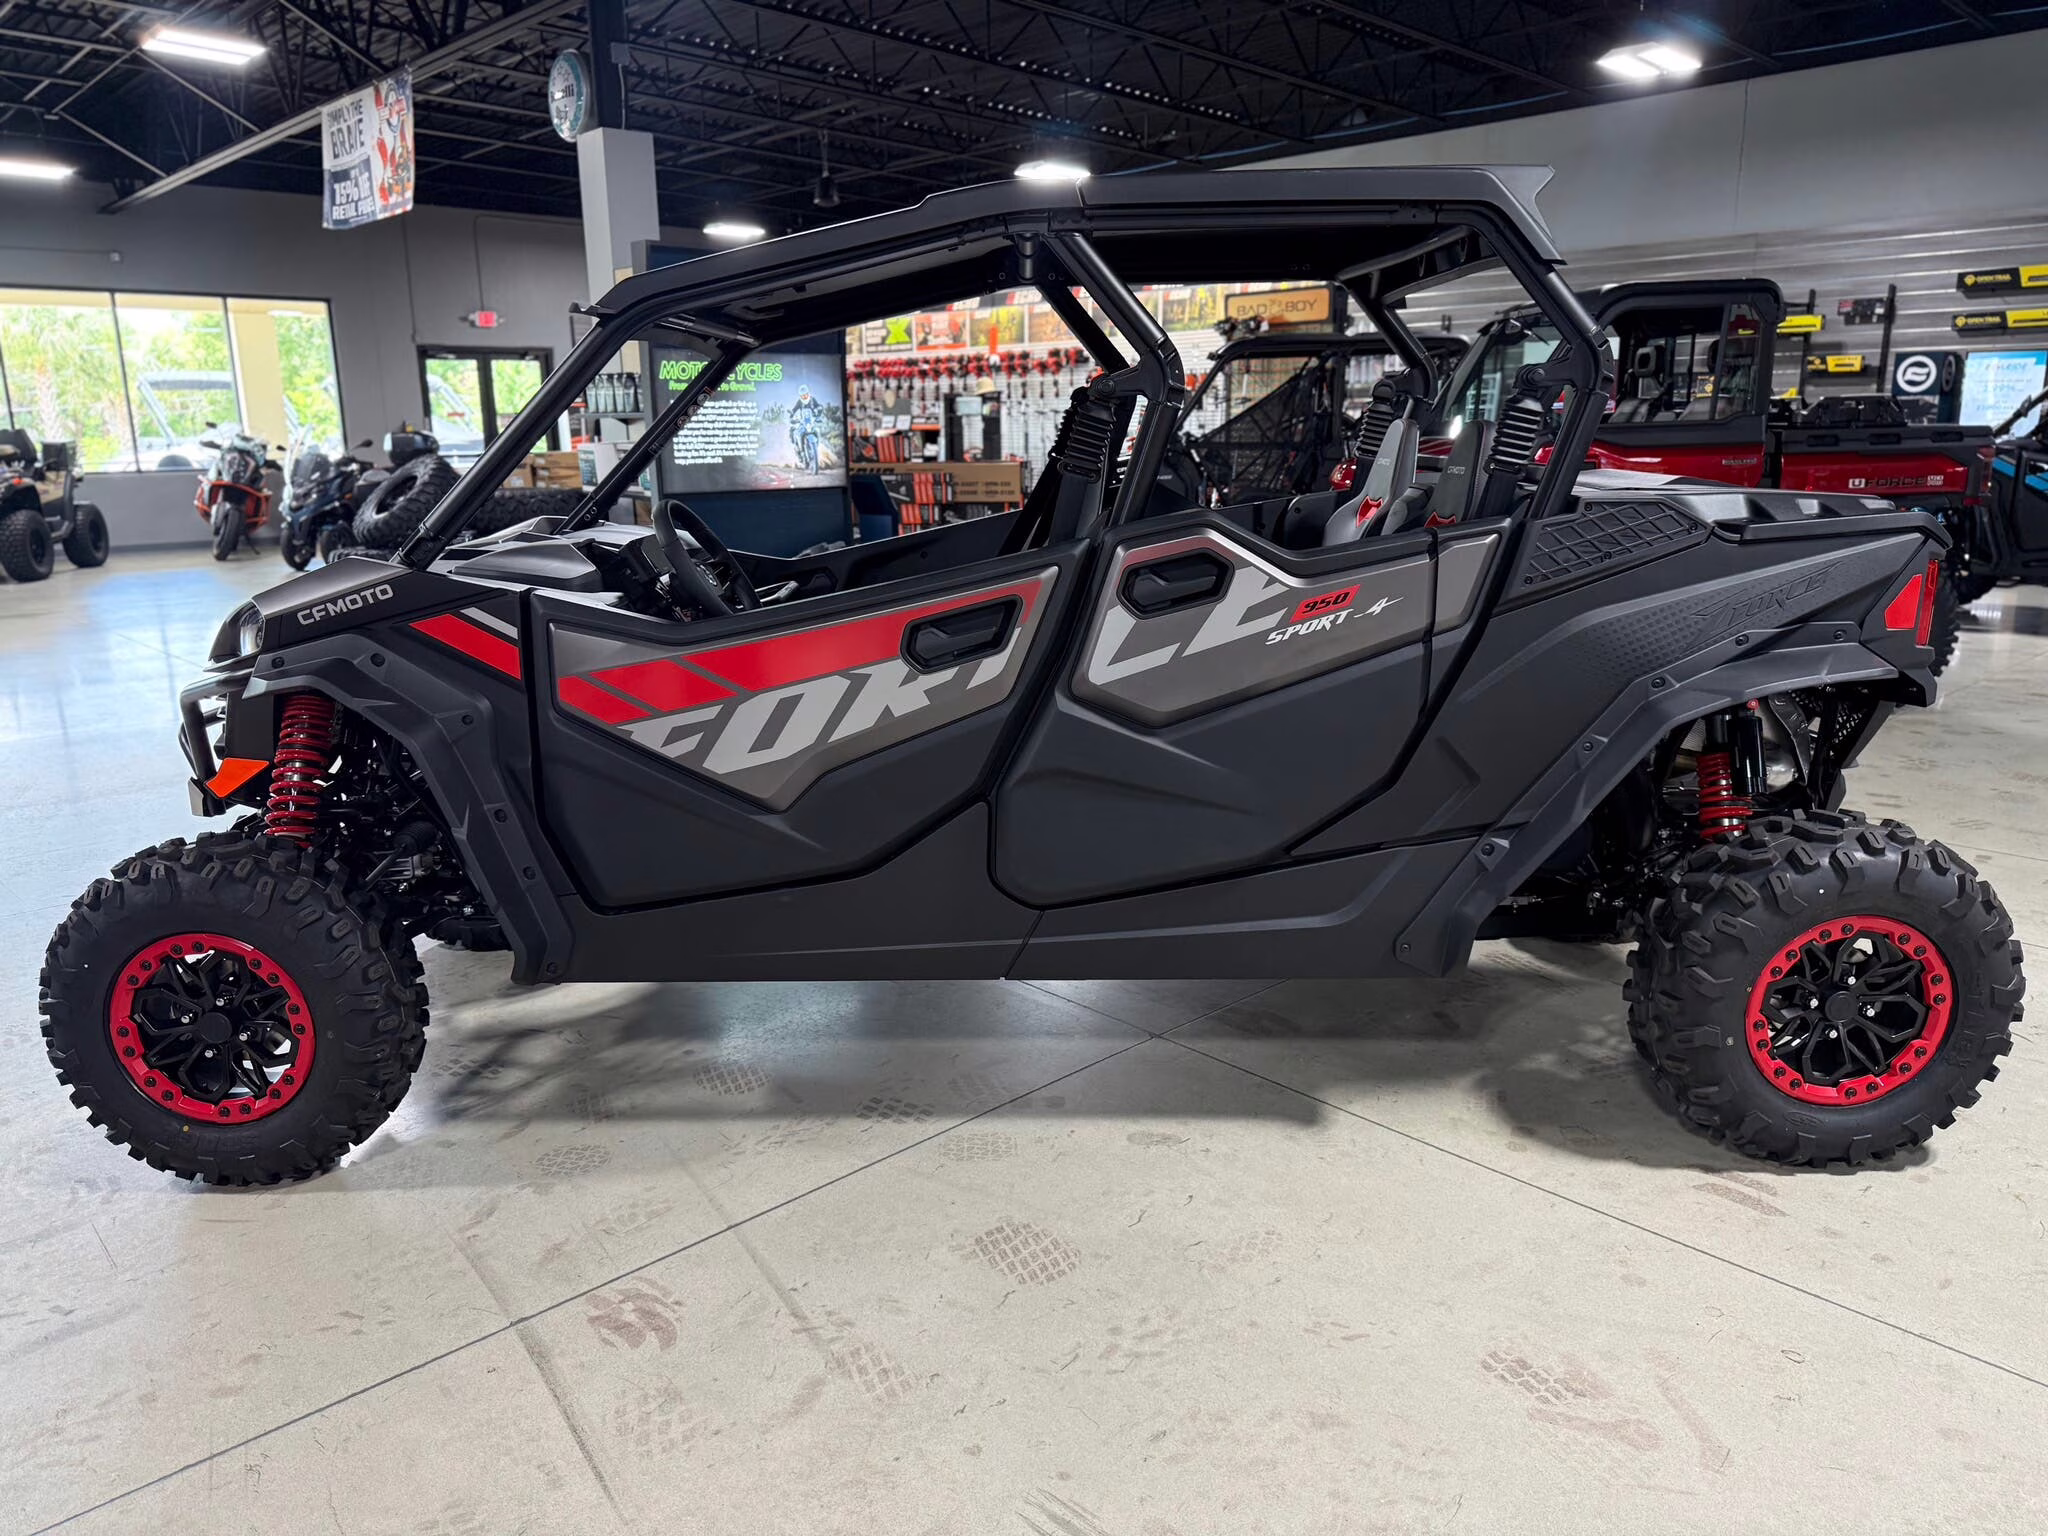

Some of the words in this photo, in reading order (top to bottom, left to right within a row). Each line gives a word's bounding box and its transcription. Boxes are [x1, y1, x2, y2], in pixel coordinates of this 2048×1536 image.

[1237, 304, 1267, 316] BAD
[1285, 298, 1318, 312] BOY
[297, 584, 394, 626] CFMOTO
[1302, 591, 1350, 615] 950
[1265, 608, 1354, 645] SPORT
